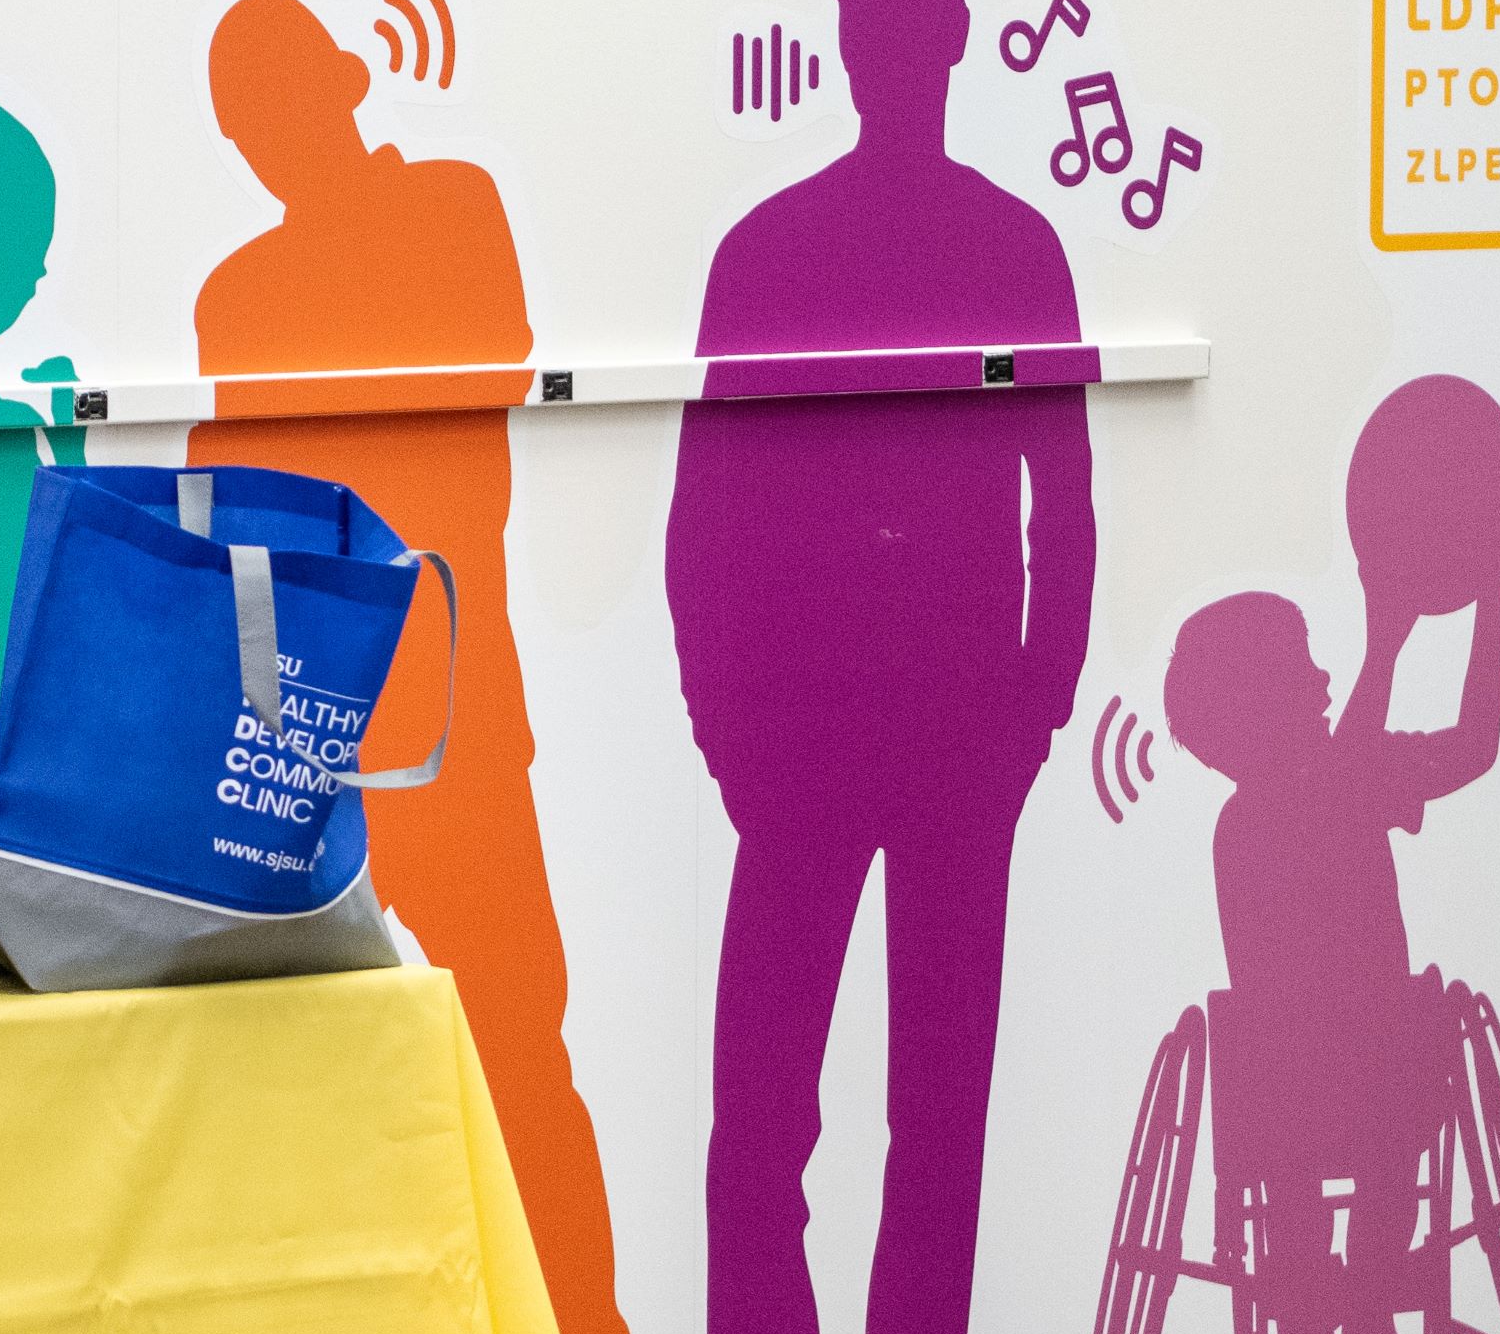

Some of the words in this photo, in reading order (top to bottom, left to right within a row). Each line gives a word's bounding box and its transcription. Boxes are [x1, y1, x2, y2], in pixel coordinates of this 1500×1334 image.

[276, 653, 303, 678] SU
[243, 692, 367, 735] ALTHY
[234, 714, 358, 766] DEVELOP
[216, 778, 315, 824] CLINIC
